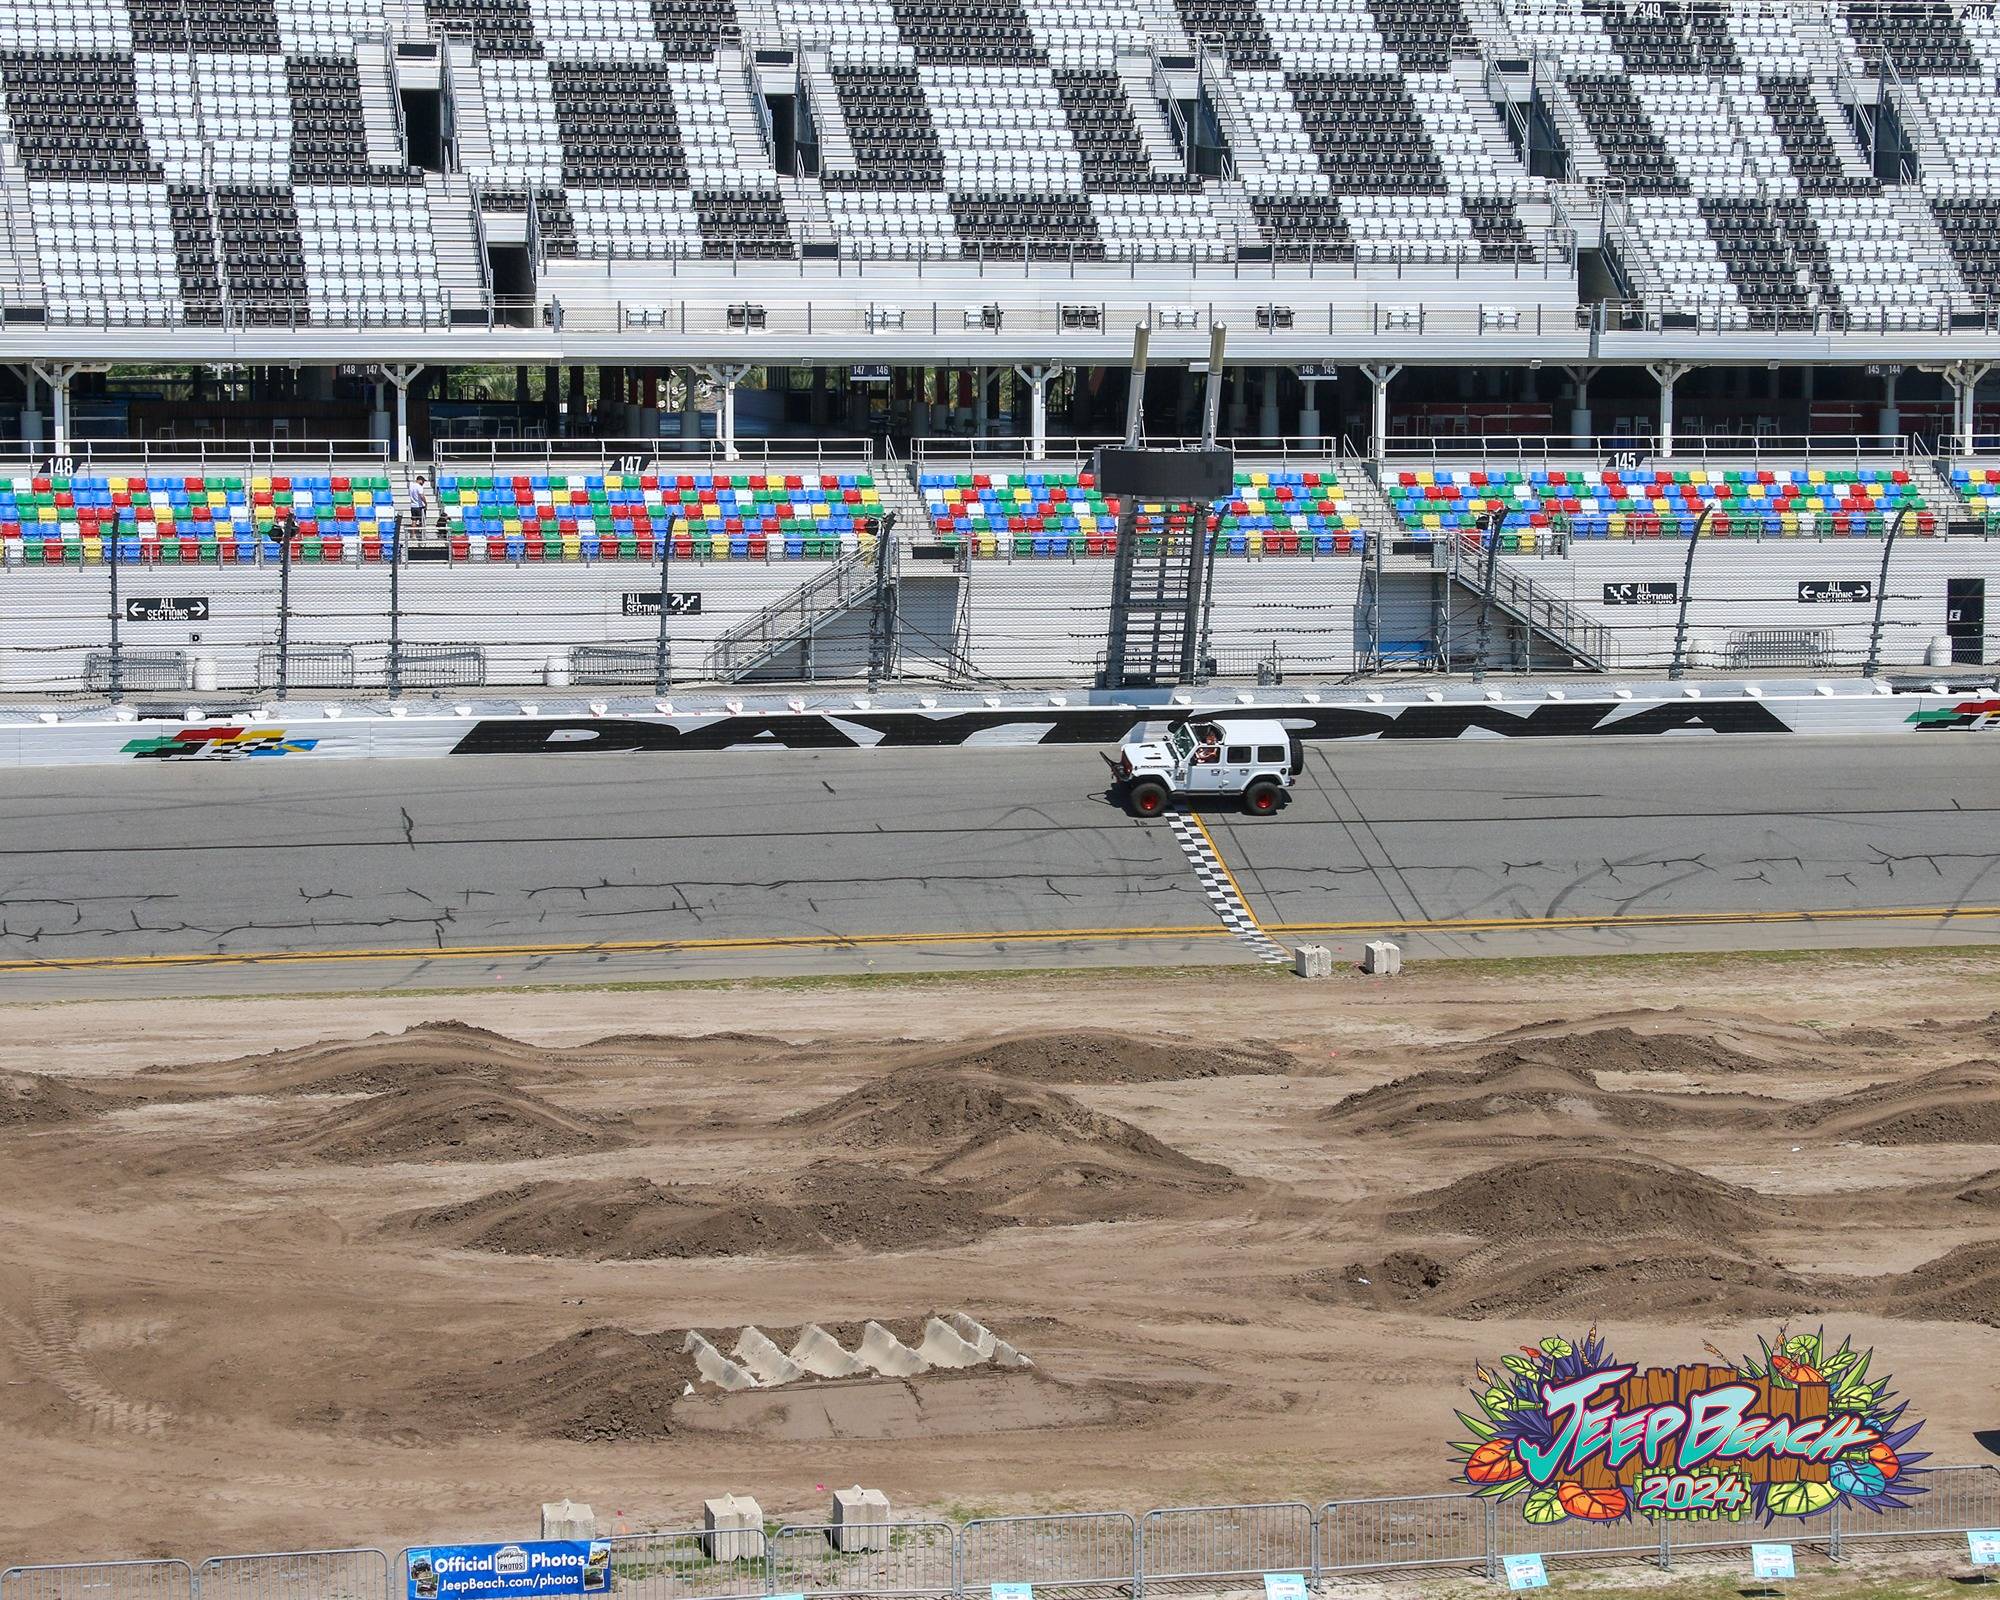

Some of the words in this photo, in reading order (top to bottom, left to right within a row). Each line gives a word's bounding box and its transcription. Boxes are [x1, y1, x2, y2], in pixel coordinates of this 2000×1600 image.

[1638, 3, 1661, 19] 349
[1965, 6, 1988, 20] 348
[343, 365, 356, 375] 148
[366, 365, 378, 375] 147
[853, 365, 865, 375] 147
[876, 365, 888, 375] 146
[1302, 365, 1314, 375] 146
[1868, 365, 1879, 374] 145
[1889, 365, 1900, 374] 144
[48, 457, 73, 477] 148
[619, 456, 642, 475] 147
[1614, 452, 1636, 471] 145
[1637, 583, 1649, 594] ALL
[1828, 581, 1841, 592] ALL
[627, 593, 641, 604] ALL
[1636, 594, 1674, 604] SECTIONS
[1816, 591, 1853, 603] SECTIONS
[159, 598, 176, 609] ALL
[147, 609, 189, 621] SECTIONS
[626, 604, 662, 616] SECTION
[1952, 611, 1959, 619] E
[192, 634, 200, 642] D
[451, 701, 1793, 754] DAYTONA
[434, 1554, 492, 1573] Official
[531, 1553, 585, 1568] Photos
[441, 1573, 579, 1592] JeepBeach.com/photos
